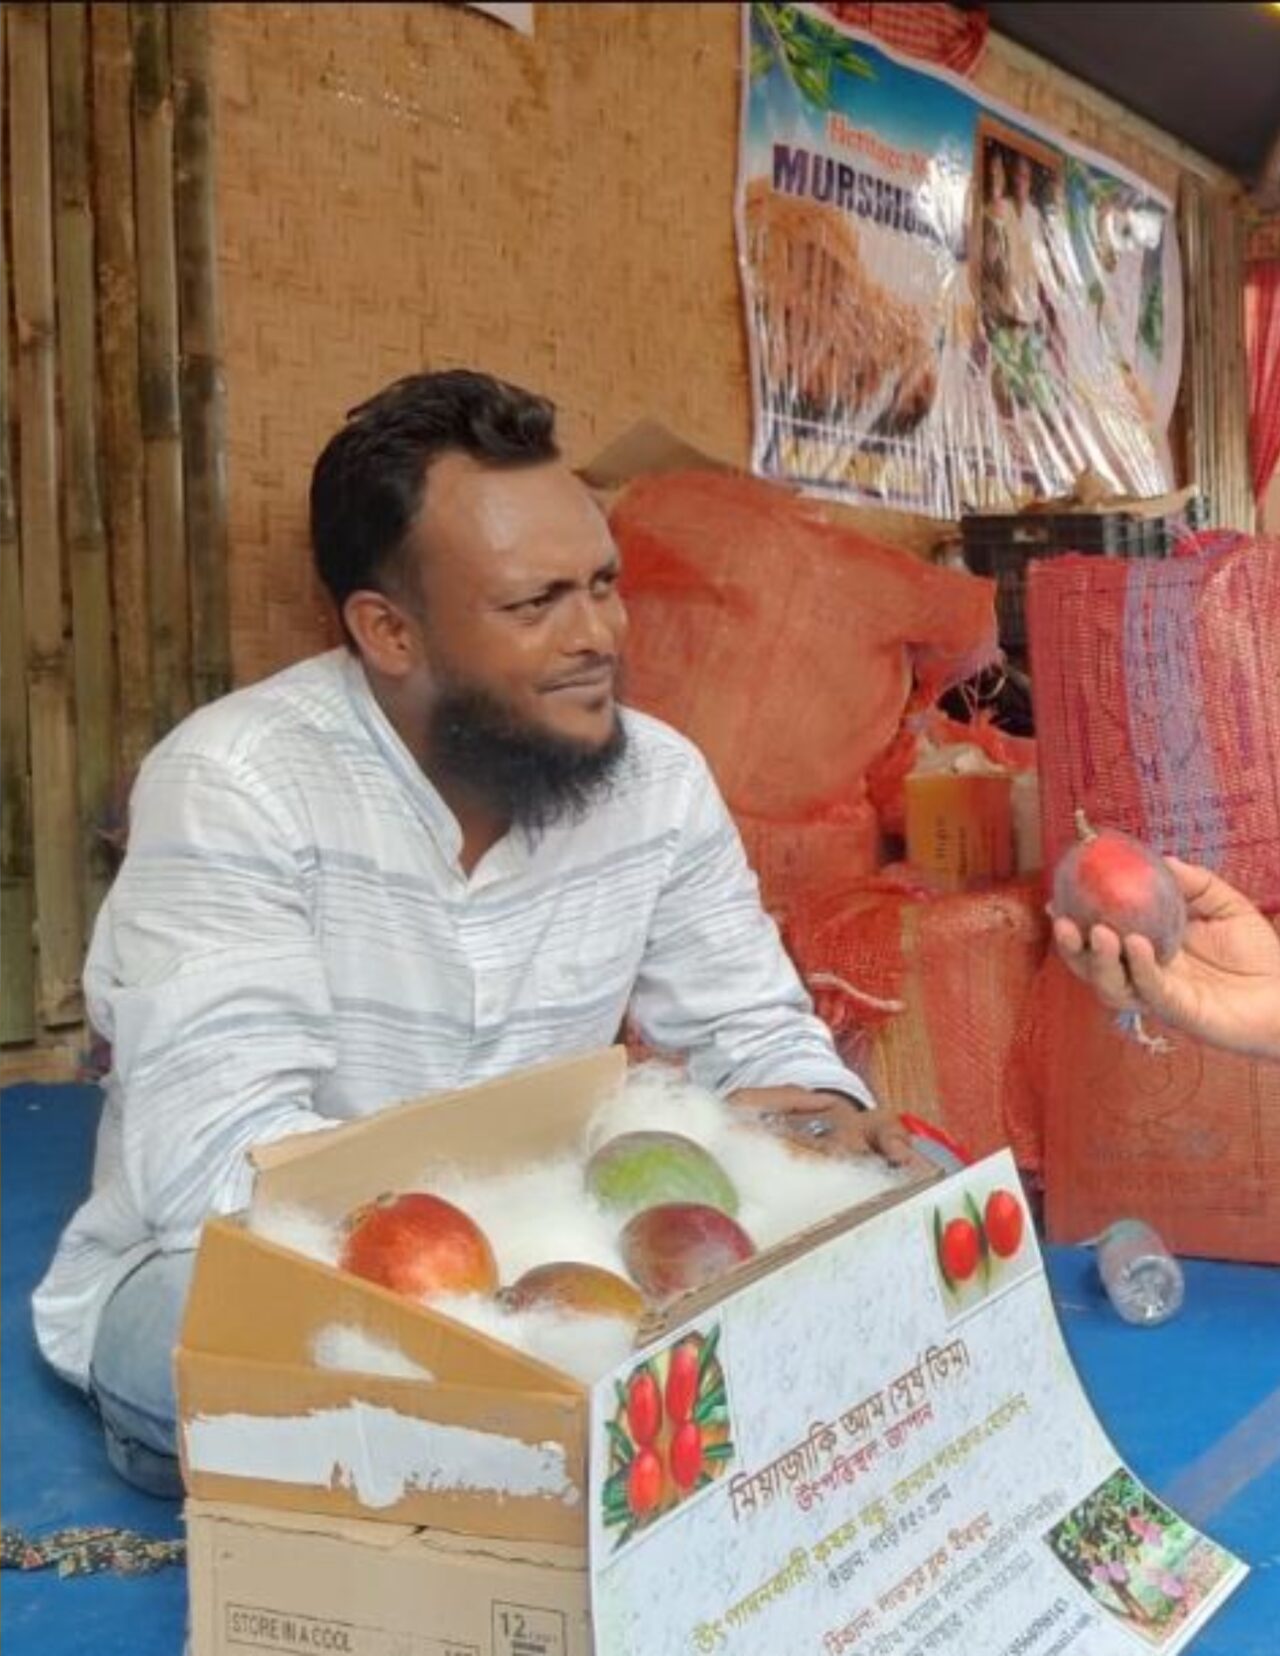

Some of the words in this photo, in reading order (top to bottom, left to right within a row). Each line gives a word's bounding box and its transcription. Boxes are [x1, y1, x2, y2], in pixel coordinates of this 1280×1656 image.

[232, 1611, 281, 1639] STORE
[282, 1622, 297, 1642] IN
[298, 1626, 310, 1643] A
[310, 1627, 354, 1653] COOL
[498, 1611, 527, 1638] 12
